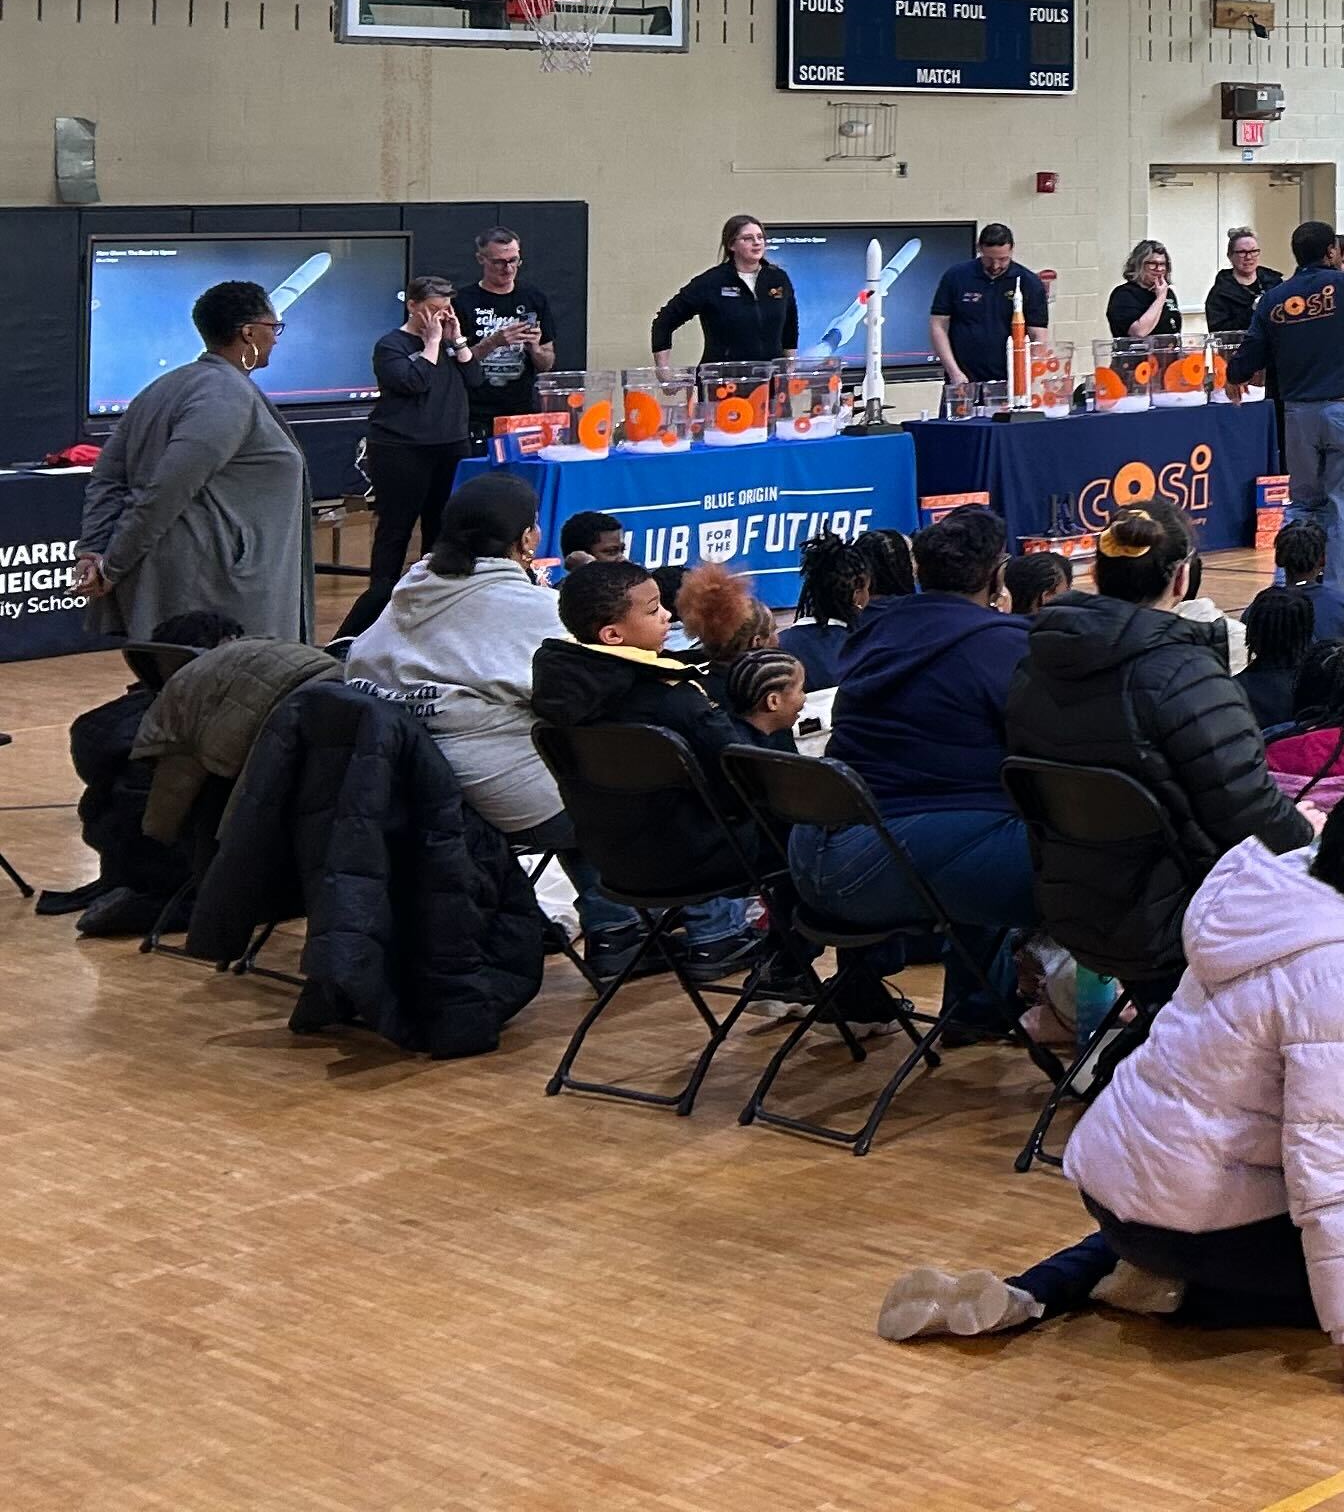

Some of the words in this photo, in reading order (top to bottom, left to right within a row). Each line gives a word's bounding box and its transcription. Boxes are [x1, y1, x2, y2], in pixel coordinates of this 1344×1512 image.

[895, 0, 946, 18] PLAYER
[953, 3, 986, 20] FOUL
[1029, 7, 1069, 23] FOULS
[799, 65, 845, 82] SCORE
[916, 68, 961, 84] MATCH
[1029, 71, 1070, 87] SCORE
[704, 491, 735, 510] BLUE
[738, 486, 778, 505] ORIGIN
[706, 529, 732, 541] FOR
[706, 541, 731, 553] THE
[0, 601, 23, 619] ity
[27, 594, 88, 614] Schoo
